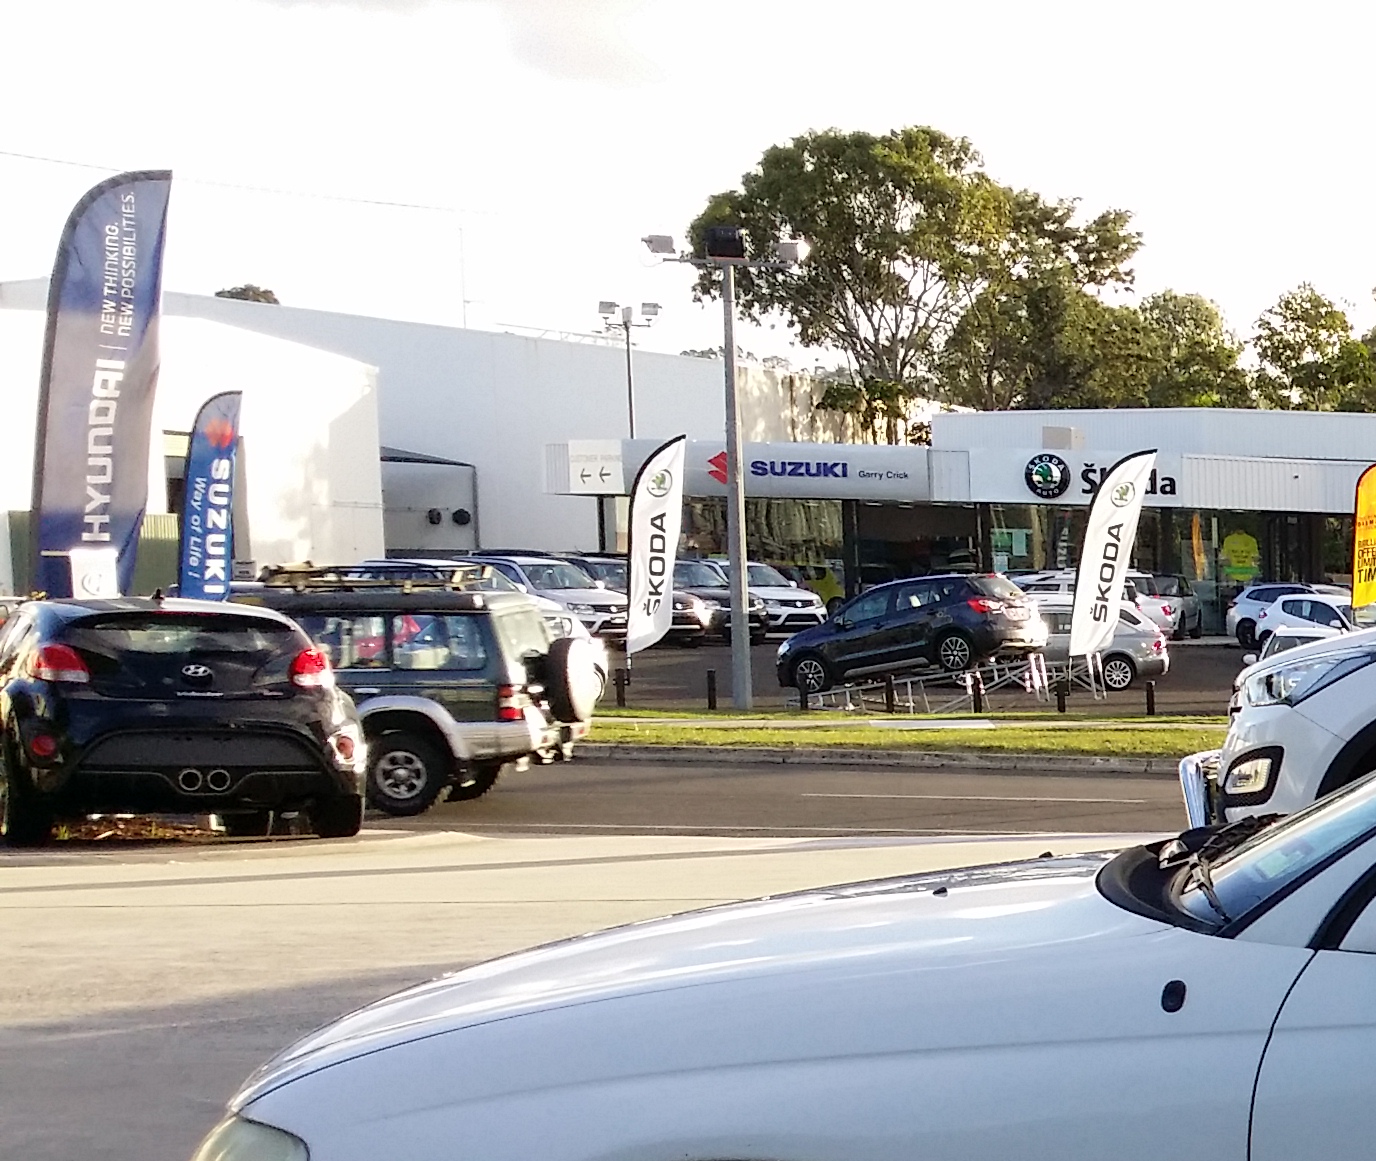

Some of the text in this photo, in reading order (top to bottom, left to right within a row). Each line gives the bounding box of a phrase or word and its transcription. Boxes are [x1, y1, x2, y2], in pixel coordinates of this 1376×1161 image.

[100, 221, 119, 335] NEW THINKING.
[117, 191, 137, 337] NEW POSSIBILITIES.
[81, 358, 126, 542] HYUNDAI
[190, 476, 207, 511] Way
[750, 460, 909, 480] SUZUKI Garry Crick
[1080, 462, 1177, 496] Šda
[188, 537, 203, 566] Life
[191, 515, 203, 534] of
[204, 458, 231, 594] SUZUKI
[643, 512, 667, 617] ŠKODA
[1089, 523, 1124, 623] ŠKODA
